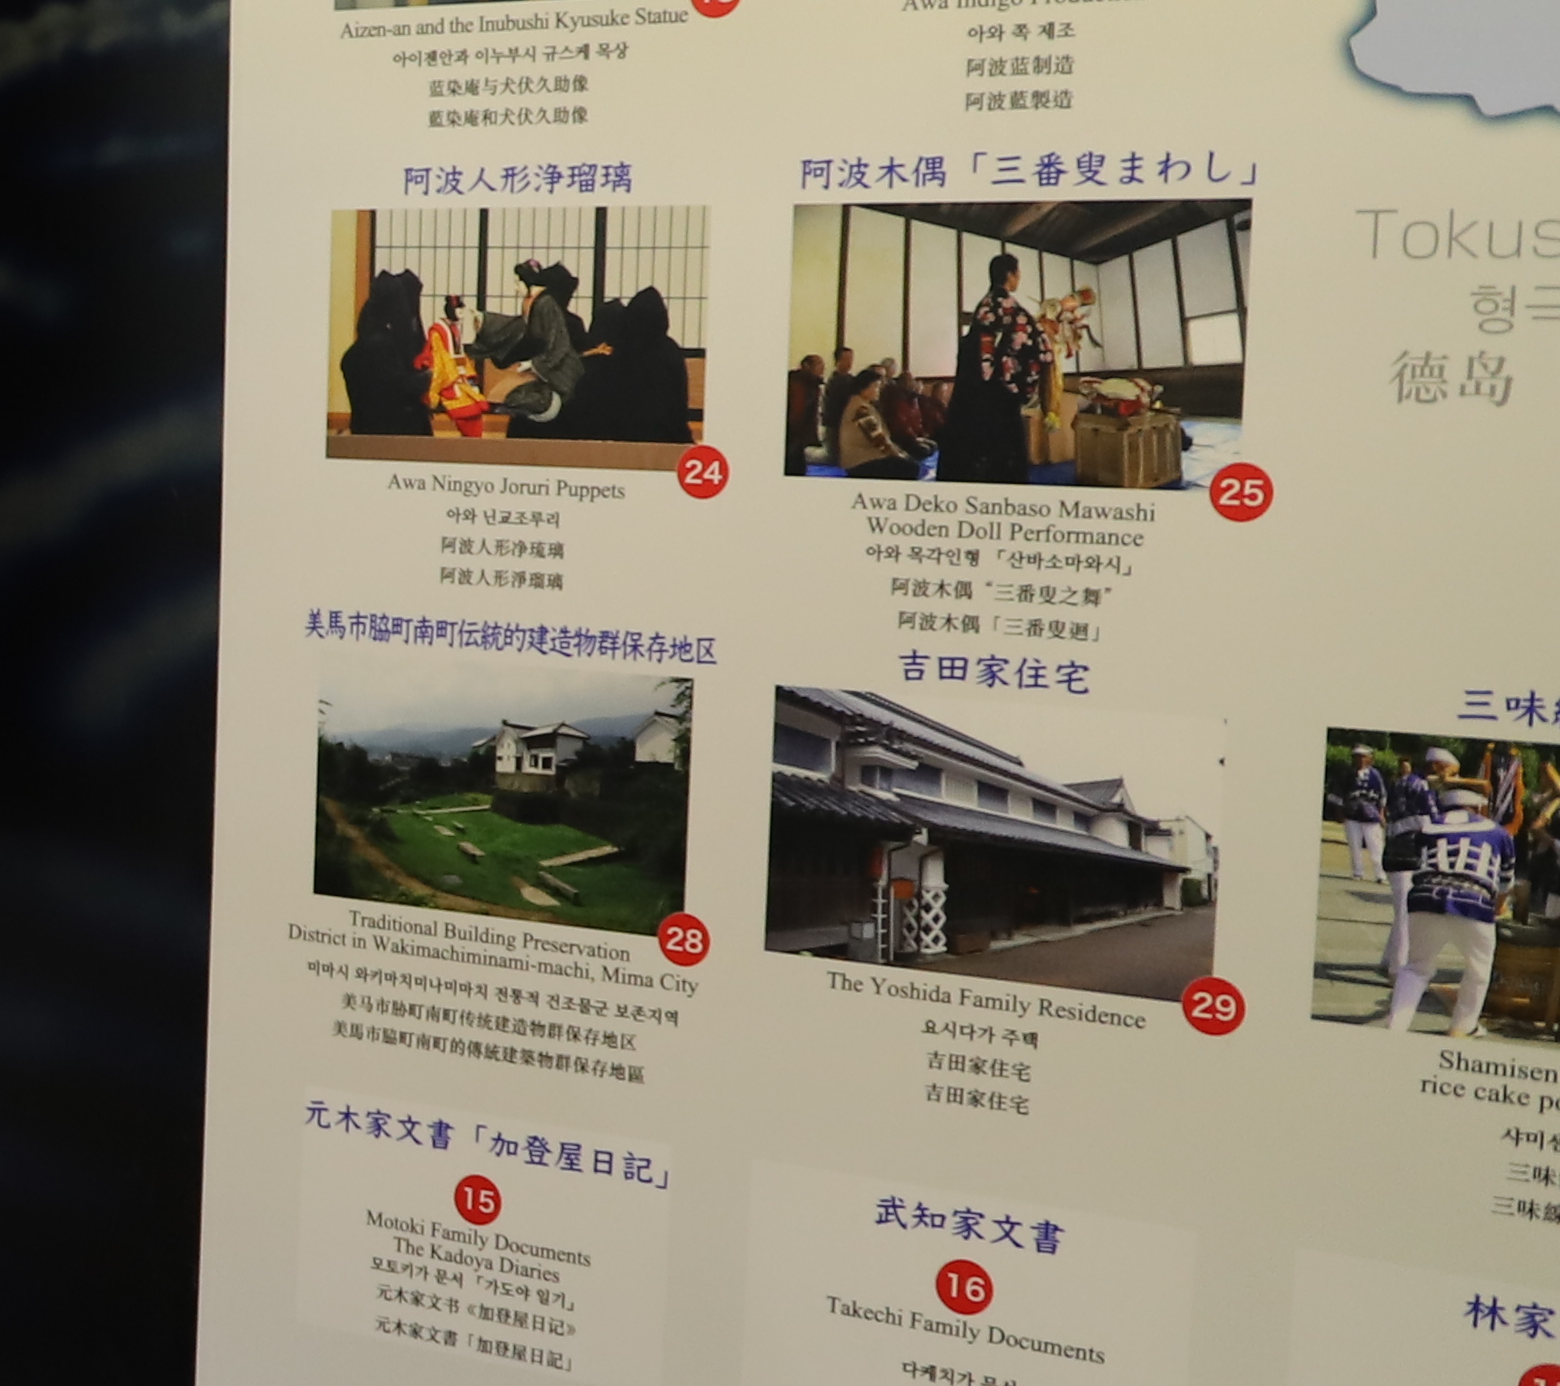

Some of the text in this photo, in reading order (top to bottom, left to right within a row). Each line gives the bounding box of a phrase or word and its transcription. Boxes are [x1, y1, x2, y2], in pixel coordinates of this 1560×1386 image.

[339, 5, 689, 40] Aizen-an and the Inubushi Kyusuke Statue
[967, 23, 1006, 44] 아와
[965, 54, 1075, 78] 阿波蓝制造
[428, 74, 589, 99] 蓝染庵与犬伏久助像
[963, 89, 1074, 113] 阿波藍製造
[428, 106, 589, 130] 藍染庵和犬伏久助像
[403, 160, 634, 196] 阿波人形浄瑠璃
[801, 149, 1261, 191] 阿波木偶「三番叟まわし」
[1355, 208, 1560, 259] Tokus
[387, 473, 626, 503] Awa Ningyo Joruri Puppets
[685, 459, 722, 485] 24
[851, 492, 1156, 523] Awa Deko Sanbaso Mawashi
[1219, 479, 1265, 506] 25
[446, 507, 477, 525] 아와
[867, 516, 1145, 548] Wooden Doll Performance
[440, 536, 566, 561] 阿波人形净琉璃
[866, 544, 901, 564] 아와
[305, 608, 719, 666] 美馬市脇町南町伝統的建造物群保存地区
[898, 649, 1092, 696] 吉田家住宅
[349, 910, 631, 963] Traditional Building Preservation
[665, 926, 704, 953] 28
[288, 923, 700, 999] District in Wakimachiminami-machi, Mima City
[307, 959, 351, 981] 미마시
[826, 970, 1147, 1030] The Yoshida Family Residence
[1190, 991, 1237, 1021] 29
[920, 1019, 997, 1046] 요시다가
[926, 1050, 1032, 1084] 吉田家住宅
[1439, 1049, 1558, 1084] Shamisen
[924, 1083, 1030, 1116] 吉田家住宅
[1420, 1073, 1530, 1107] rice cake
[305, 1100, 671, 1192] 元木家文書「加登屋日記」
[462, 1185, 496, 1214] 15
[366, 1209, 592, 1268] Motoki Family Documents
[875, 1194, 1065, 1256] 武知家文書
[394, 1235, 561, 1285] The Kadoya Diaries
[945, 1272, 986, 1303] 16
[376, 1283, 577, 1339] 元木家文书《加登屋日记》
[1464, 1292, 1556, 1340] 林家
[374, 1315, 575, 1373] 元木家文書「加登屋日記」
[827, 1295, 1106, 1366] Takechi Family Documents
